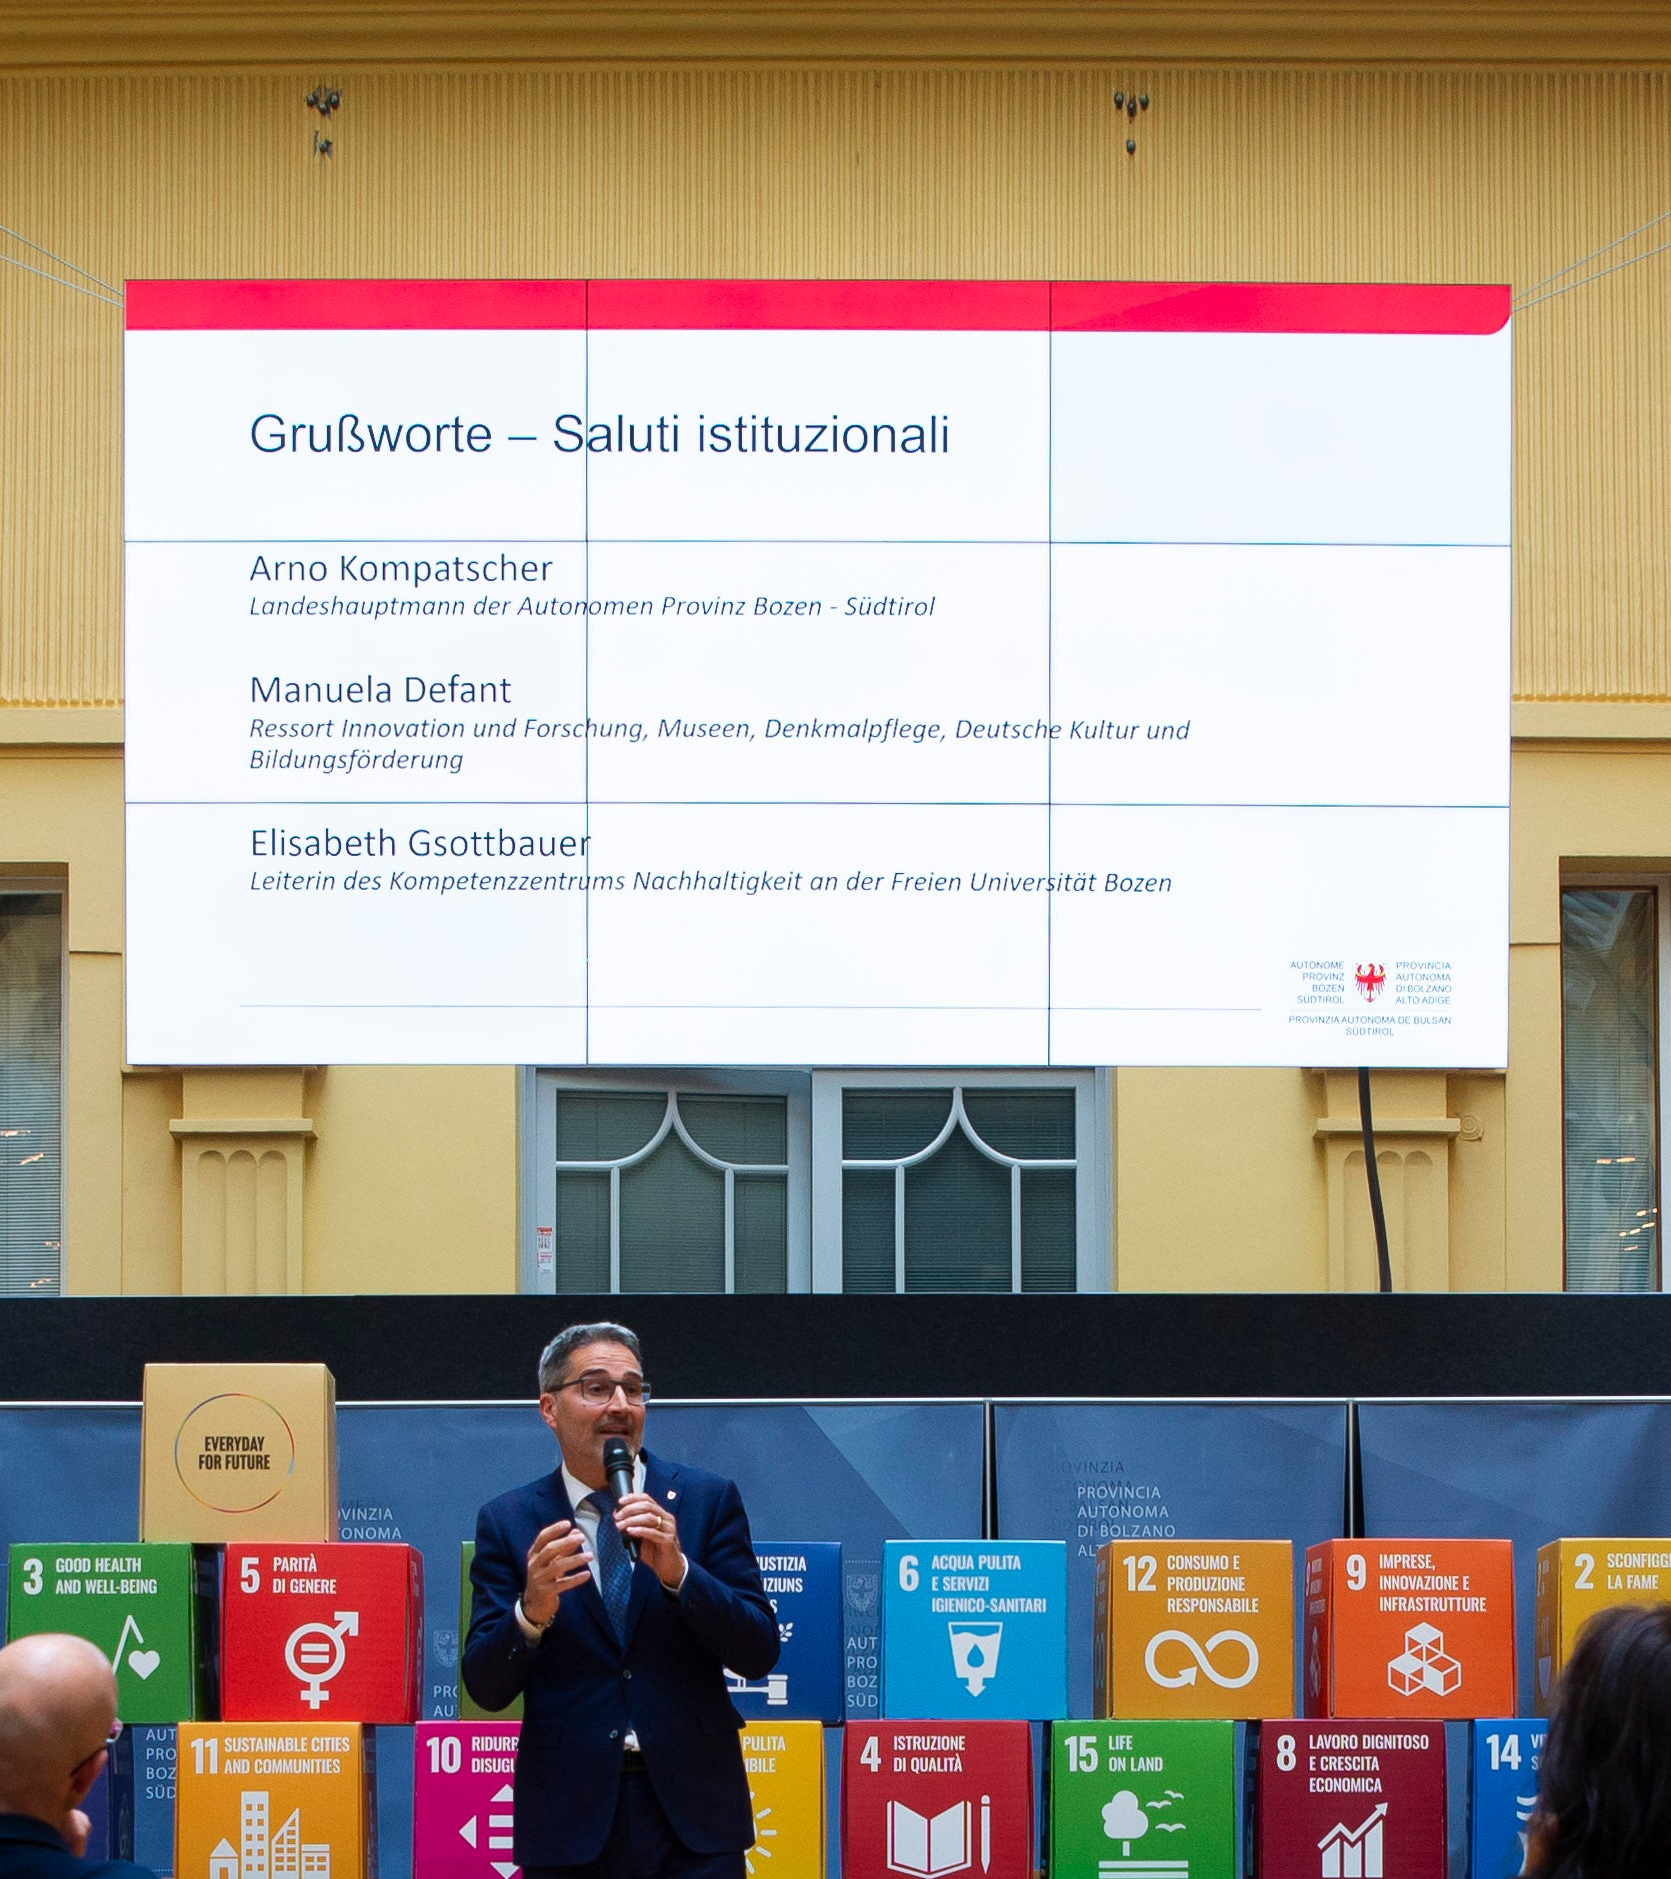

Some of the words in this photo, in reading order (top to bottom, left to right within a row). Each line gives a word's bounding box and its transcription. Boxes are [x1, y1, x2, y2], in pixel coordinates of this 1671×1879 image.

[252, 414, 491, 452] Grußworte
[554, 415, 678, 452] Saluti
[700, 415, 947, 453] istituzionali
[250, 556, 327, 581] Arno
[342, 554, 553, 588] Kompatscher
[251, 596, 464, 620] Landeshauptmann
[474, 596, 511, 615] der
[517, 596, 652, 618] Autonomen
[662, 597, 745, 615] Provinz
[754, 598, 821, 615] Bozen
[845, 596, 935, 616] Südtirol
[252, 675, 390, 703] Manuela
[406, 676, 511, 703] Defant
[250, 719, 334, 737] Ressort
[342, 719, 464, 737] Innovation
[474, 718, 516, 737] und
[524, 718, 647, 742] Forschung,
[659, 719, 754, 741] Museen,
[766, 718, 945, 743] Denkmalpflege,
[956, 719, 1061, 739] Deutsche
[1070, 720, 1139, 739] Kultur
[1147, 720, 1190, 740] und
[251, 749, 463, 774] Bildungsförderung
[253, 828, 395, 856] Elisabeth
[409, 829, 591, 856] Gsottbauer
[251, 871, 334, 890] Leiterin
[344, 870, 381, 890] des
[390, 872, 624, 896] Kompetenzzentrums
[634, 871, 802, 895] Nachhaltigkeit
[811, 877, 837, 890] an
[847, 871, 884, 890] der
[892, 872, 960, 891] Freien
[971, 872, 1097, 891] Universität
[1105, 870, 1171, 892] Bozen
[1290, 961, 1344, 970] AUTONOME
[1396, 962, 1451, 970] PROVINCIA
[1303, 973, 1344, 981] PROVINZ
[1396, 985, 1405, 993] DI
[1407, 985, 1452, 993] BOLZANO
[1297, 995, 1344, 1004] SÜDTIROL
[1289, 1016, 1339, 1024] PROVINZIA
[1342, 1016, 1395, 1024] AUTONOMA
[1398, 1016, 1410, 1024] DE
[1414, 1016, 1451, 1024] BULSAN
[1346, 1027, 1394, 1036] SÜDTIROL
[205, 1436, 264, 1451] EVERYDAY
[199, 1455, 221, 1470] FOR
[226, 1455, 270, 1469] FUTURE
[1078, 1486, 1160, 1499] PROVINCIA
[1078, 1506, 1168, 1518] AUTONOMA
[1078, 1525, 1093, 1537] DI
[1101, 1525, 1176, 1538] BOLZANO
[56, 1558, 91, 1572] GOOD
[95, 1558, 141, 1572] HEALTH
[274, 1554, 317, 1572] PARITÀ
[932, 1555, 974, 1571] ACQUA
[979, 1555, 1021, 1570] PULITA
[1168, 1555, 1228, 1570] CONSUMO
[1233, 1555, 1240, 1569] E
[1380, 1554, 1435, 1570] IMPRESE,
[24, 1558, 43, 1595] 3
[241, 1557, 260, 1593] 5
[900, 1555, 919, 1591] 6
[1123, 1556, 1157, 1591] 12
[1347, 1555, 1366, 1590] 9
[1575, 1554, 1594, 1589] 2
[56, 1580, 81, 1594] AND
[86, 1579, 157, 1594] WELL-BEING
[273, 1579, 285, 1593] DI
[290, 1579, 336, 1594] GENERE
[932, 1577, 938, 1591] E
[943, 1577, 989, 1591] SERVIZI
[1168, 1577, 1245, 1591] PRODUZIONE
[1380, 1576, 1458, 1590] INNOVAZIONE
[1463, 1576, 1469, 1590] E
[1608, 1575, 1622, 1589] LA
[1627, 1575, 1658, 1589] FAME
[932, 1598, 1046, 1612] IGIENICO-SANITARI
[1168, 1598, 1258, 1612] RESPONSABILE
[1380, 1597, 1486, 1611] INFRASTRUTTURE
[225, 1737, 307, 1752] SUSTAINABLE
[312, 1737, 349, 1752] CITIES
[743, 1736, 785, 1751] PULITA
[894, 1736, 965, 1750] ISTRUZIONE
[1109, 1736, 1132, 1750] LIFE
[1310, 1735, 1358, 1749] LAVORO
[1363, 1735, 1429, 1749] DIGNITOSO
[191, 1738, 218, 1773] 11
[427, 1737, 461, 1773] 10
[861, 1737, 881, 1772] 4
[1065, 1736, 1098, 1772] 15
[1277, 1735, 1296, 1771] 8
[1487, 1735, 1521, 1770] 14
[225, 1759, 250, 1773] AND
[255, 1759, 340, 1773] COMMUNITIES
[894, 1757, 906, 1772] DI
[910, 1752, 963, 1774] QUALITÀ
[1109, 1757, 1126, 1771] ON
[1131, 1757, 1163, 1771] LAND
[1310, 1756, 1316, 1771] E
[1321, 1756, 1379, 1771] CRESCITA
[1310, 1778, 1382, 1792] ECONOMICA
